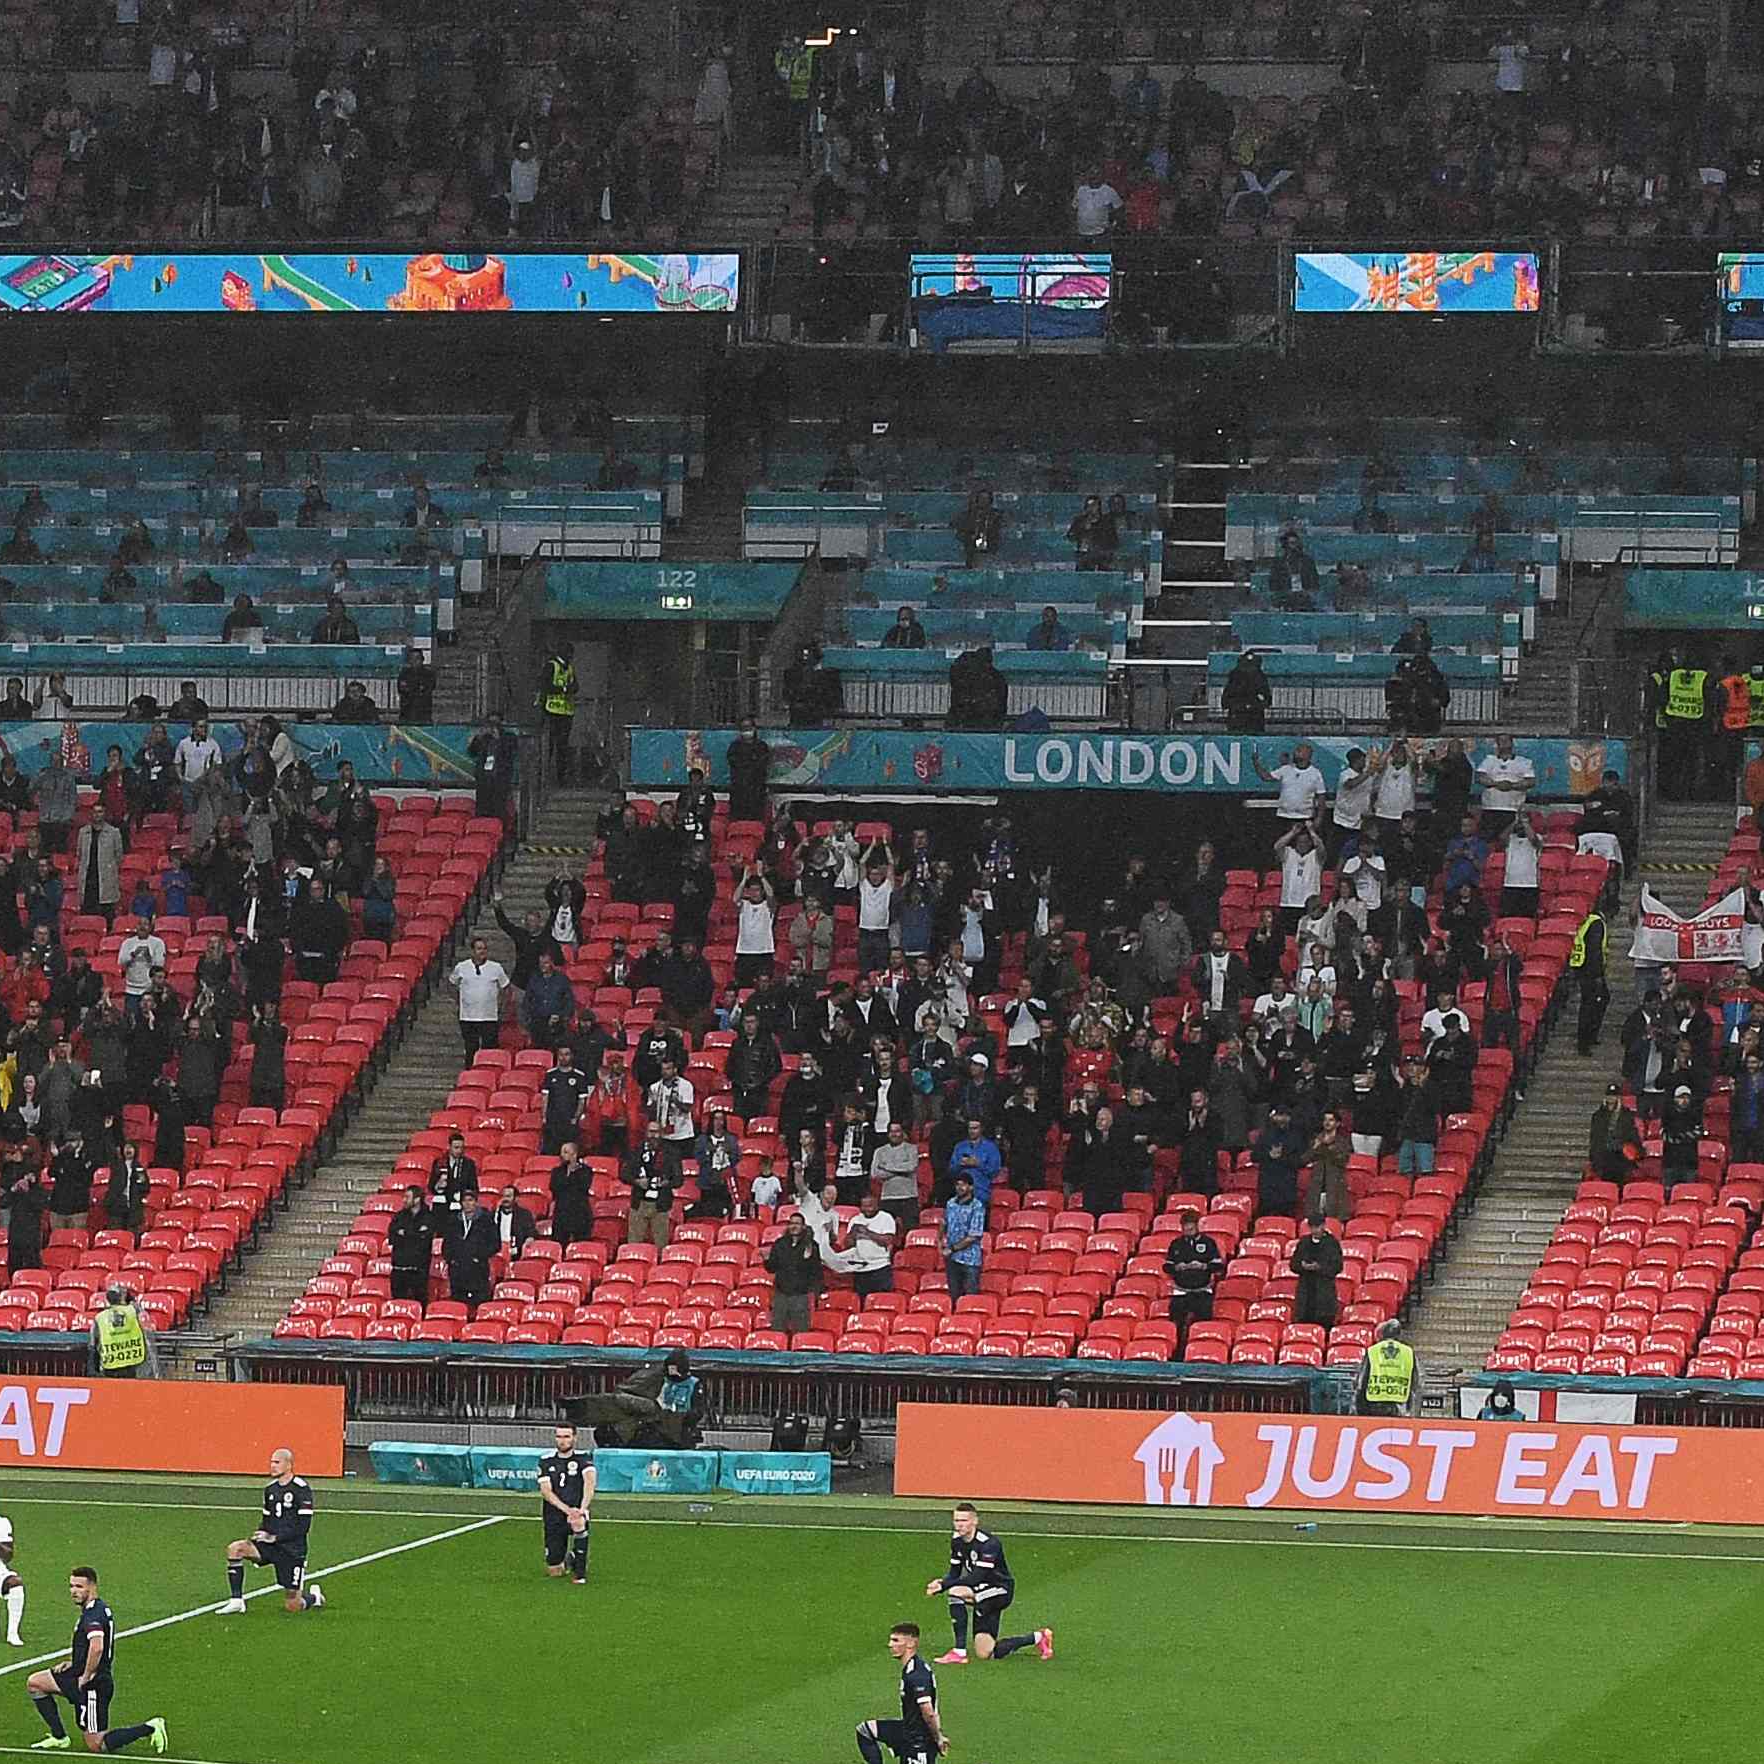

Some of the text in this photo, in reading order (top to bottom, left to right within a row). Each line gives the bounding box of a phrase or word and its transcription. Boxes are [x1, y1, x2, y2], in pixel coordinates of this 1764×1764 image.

[657, 570, 696, 588] 122
[1005, 739, 1241, 784] LONDON
[487, 1468, 515, 1479] UEFA
[736, 1469, 816, 1481] UEFA EURO 2020
[1246, 1424, 1679, 1509] JUST EAT
[276, 1502, 282, 1518] 9
